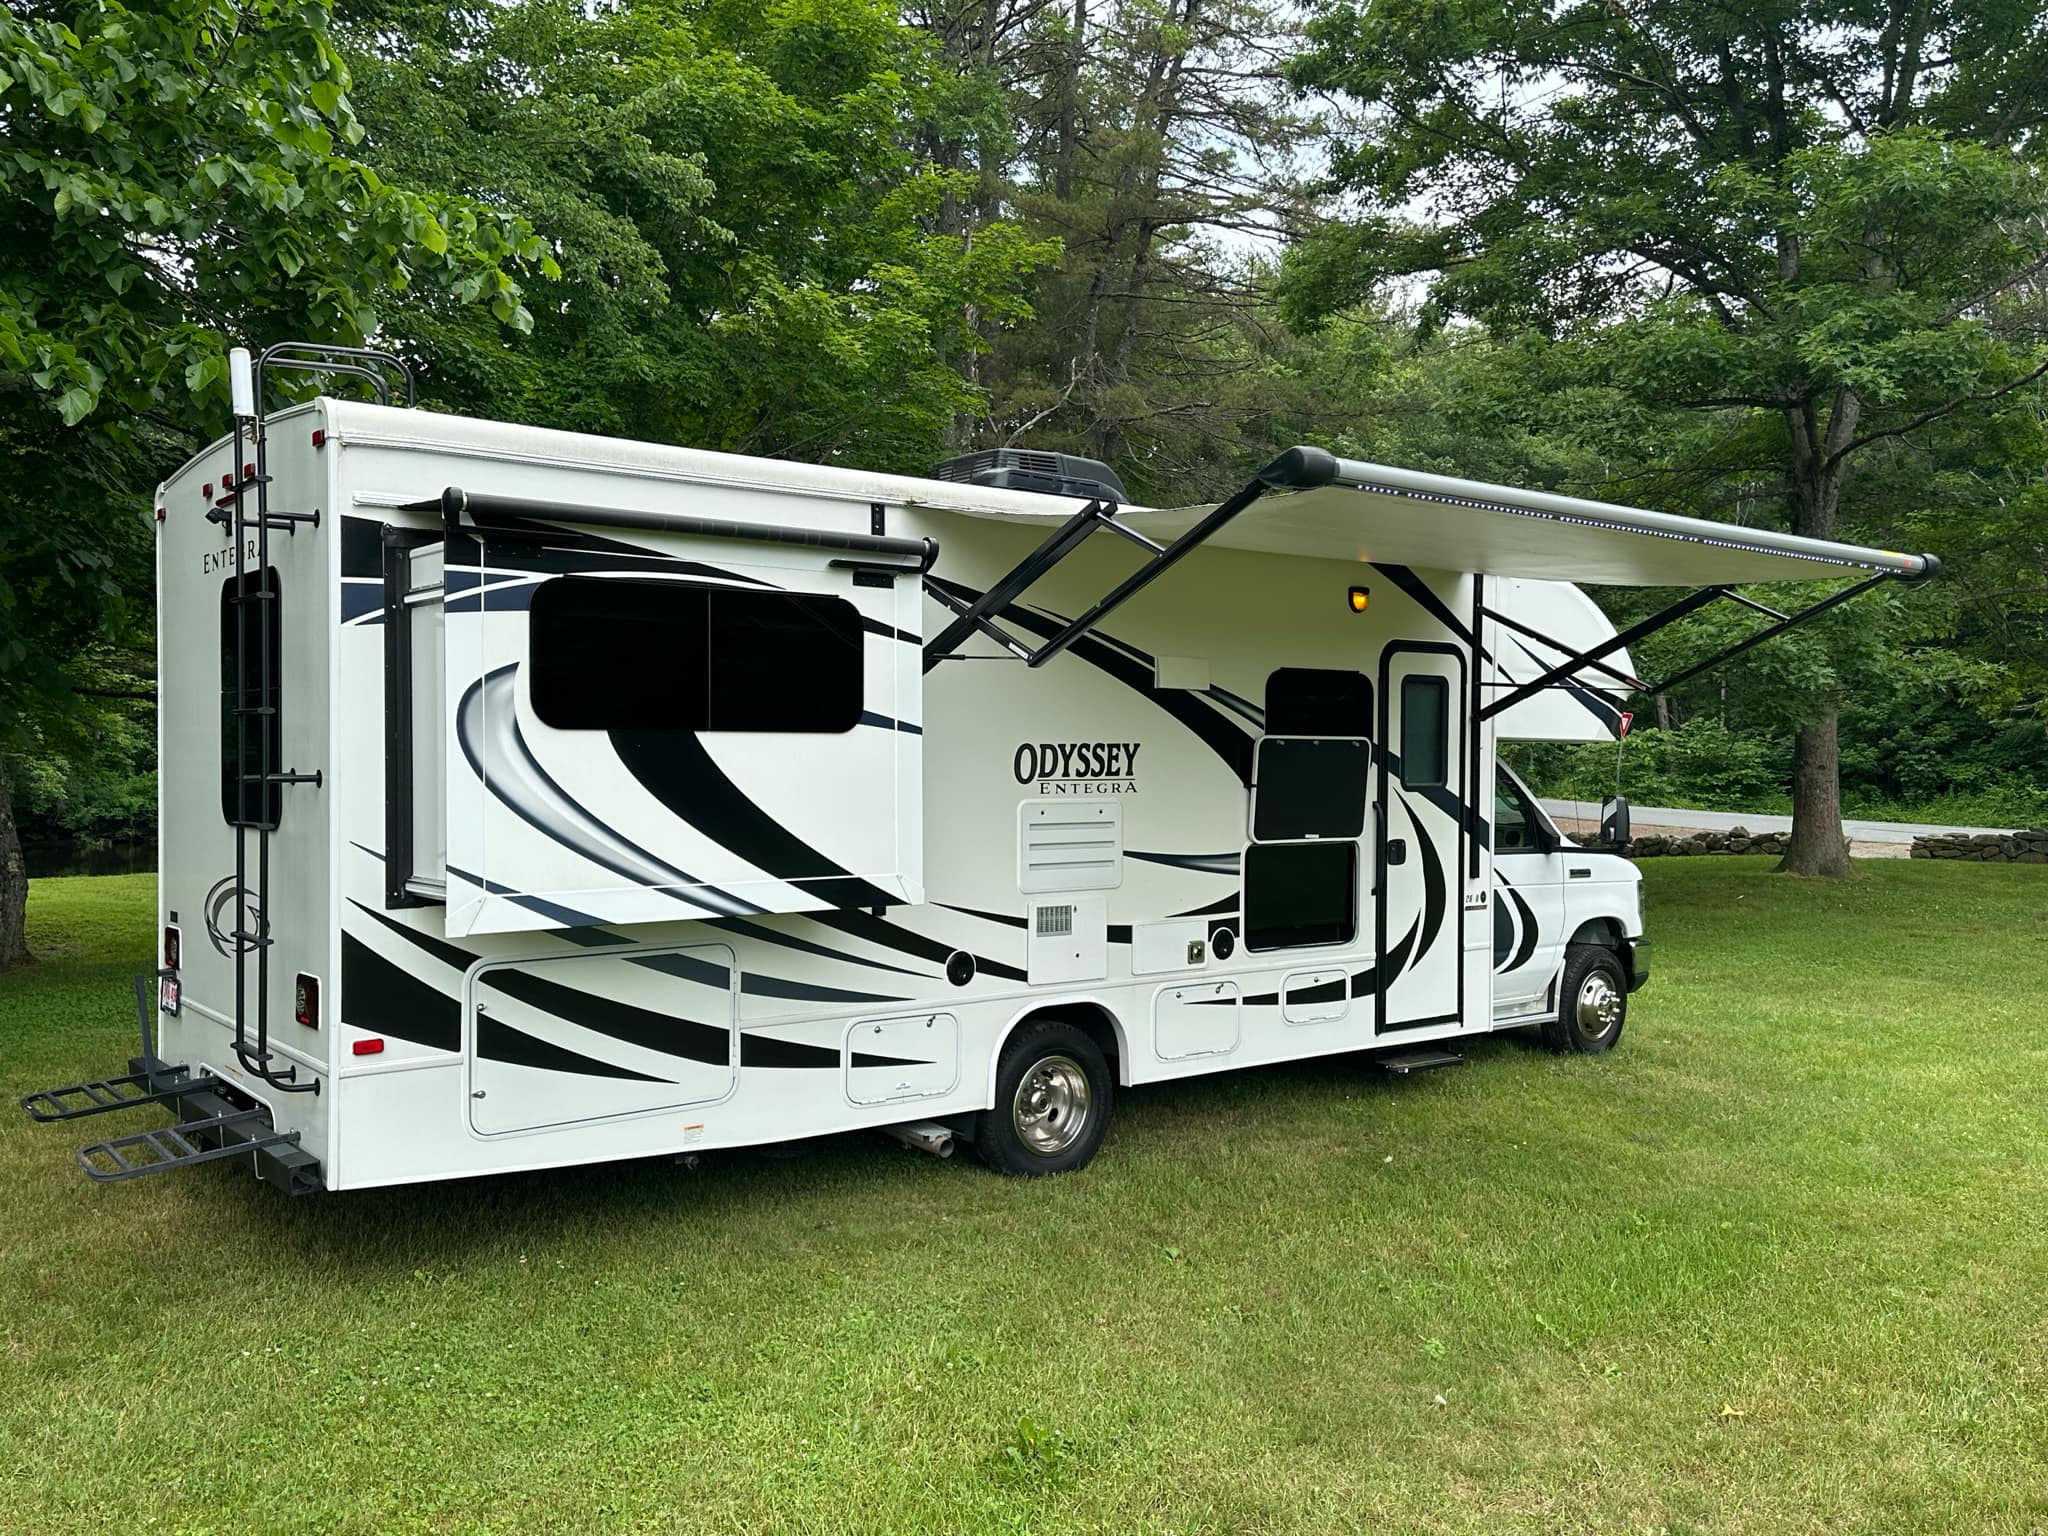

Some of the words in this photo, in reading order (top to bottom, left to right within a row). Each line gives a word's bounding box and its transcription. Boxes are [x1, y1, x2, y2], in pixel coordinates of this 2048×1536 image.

[203, 540, 262, 575] ENTER
[1013, 743, 1141, 785] ODYSSEY
[1039, 781, 1138, 795] ENTEGRA
